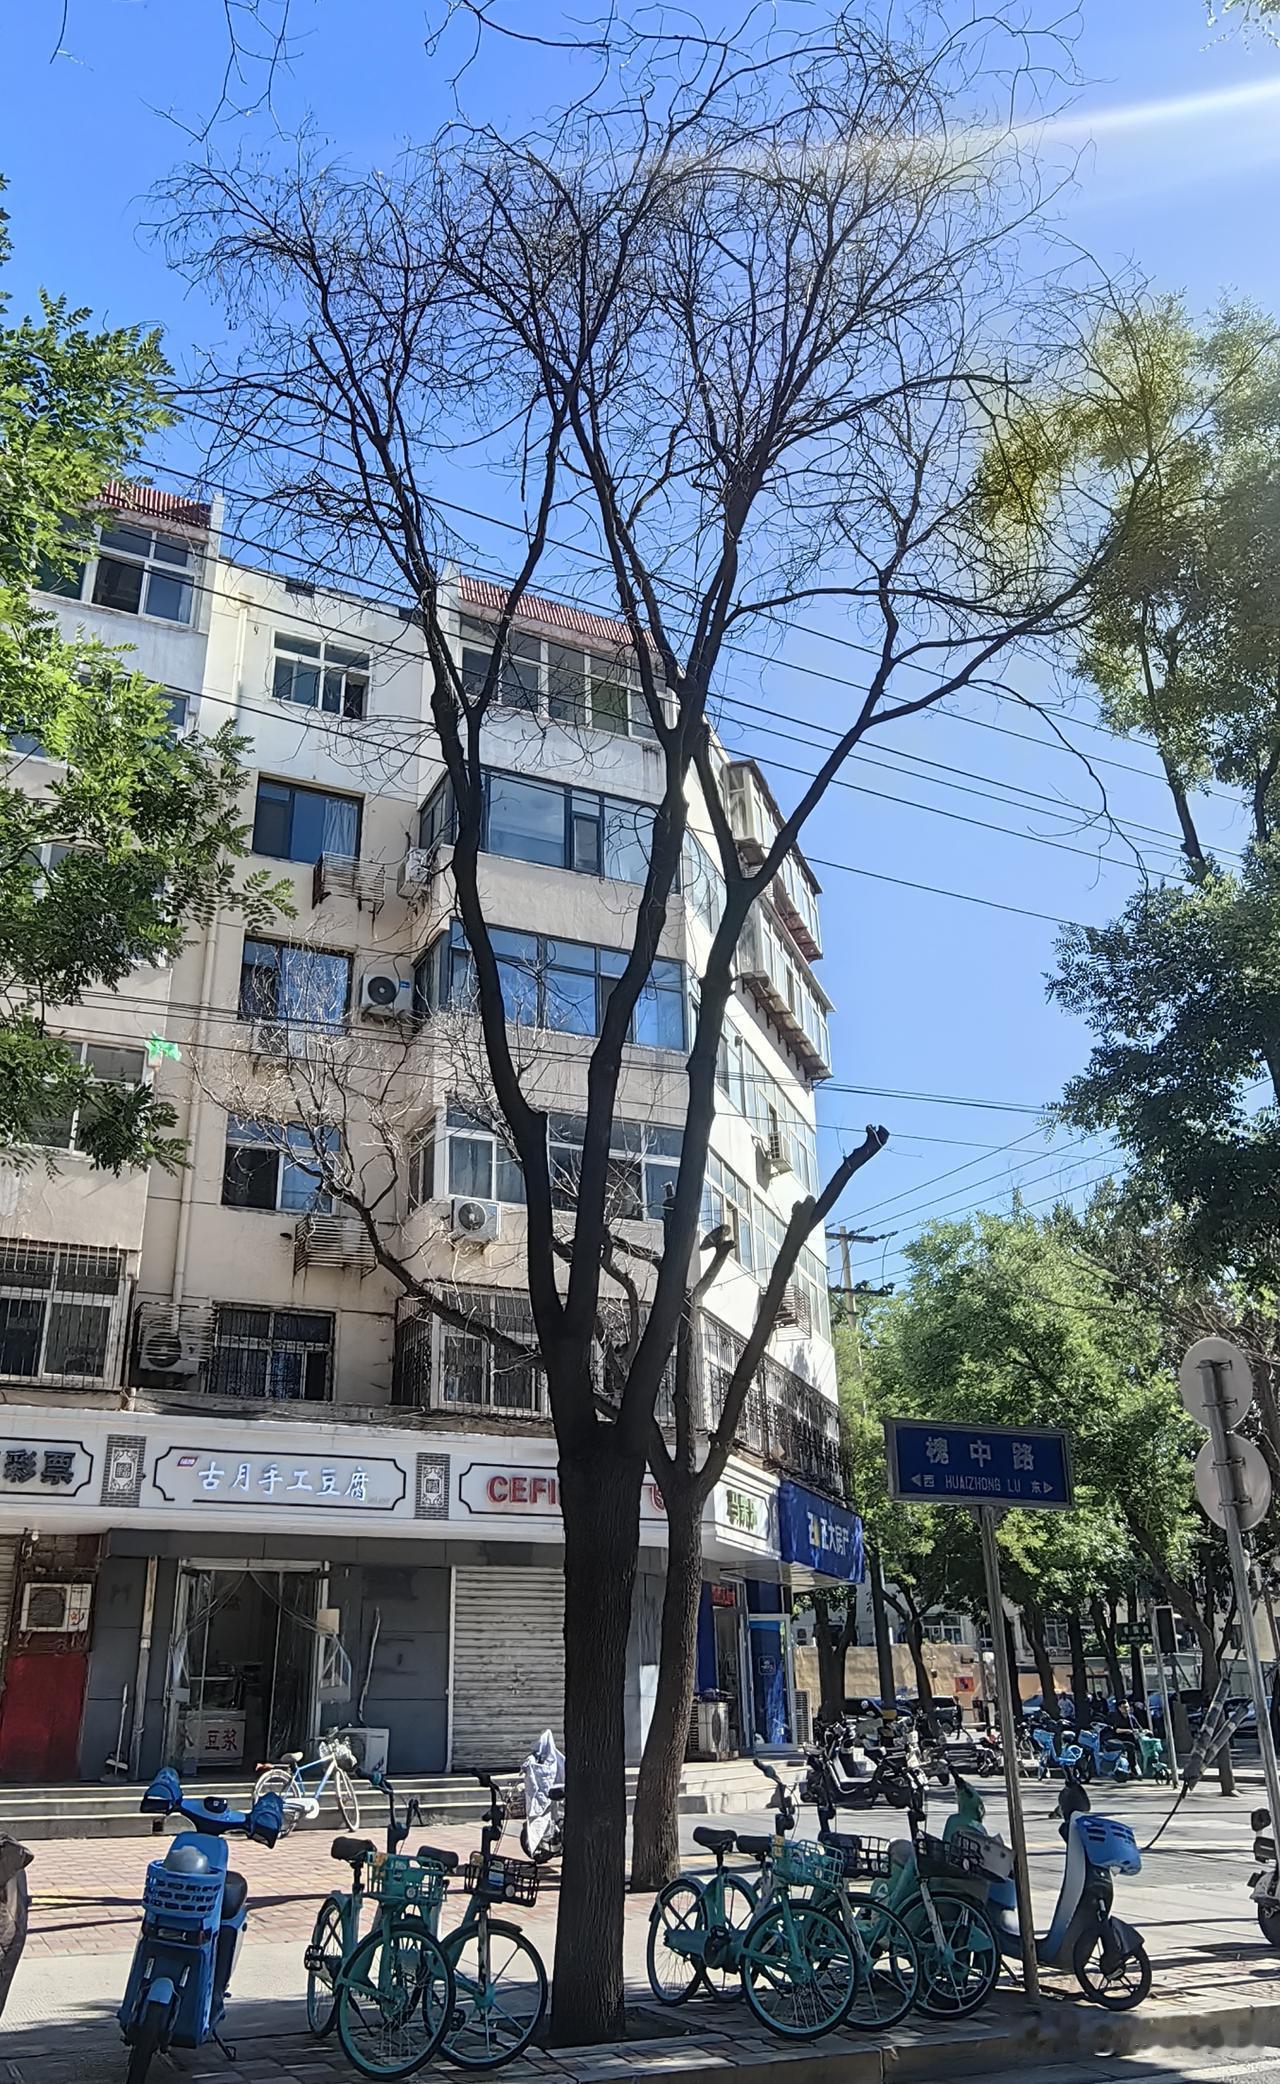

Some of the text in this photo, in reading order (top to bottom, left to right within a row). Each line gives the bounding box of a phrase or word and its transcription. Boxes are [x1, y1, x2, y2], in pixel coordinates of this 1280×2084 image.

[2, 1449, 76, 1486] 彩票
[926, 1436, 1034, 1471] 槐中路
[198, 1461, 369, 1501] 古月手工豆腐
[923, 1474, 935, 1488] 西
[945, 1474, 1001, 1492] HUAIZHONG
[1007, 1479, 1021, 1493] LU
[205, 1728, 238, 1751] 豆浆
